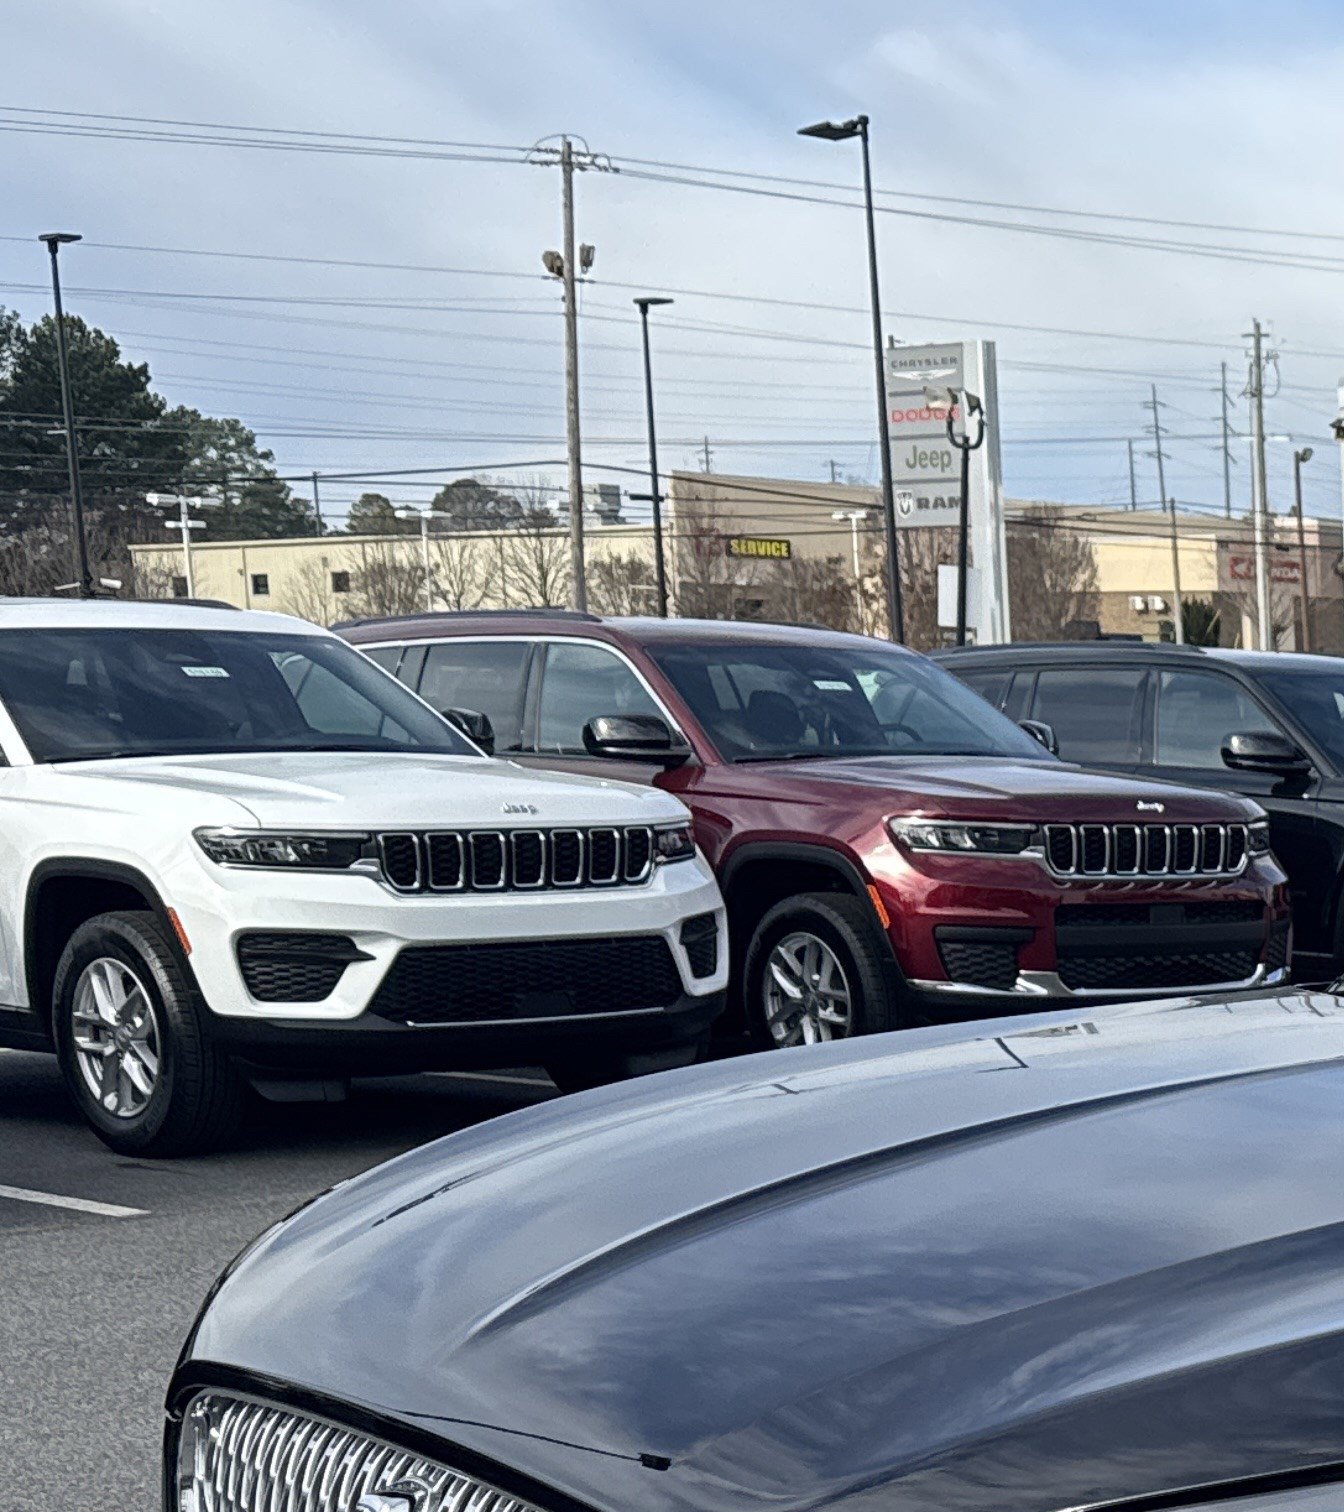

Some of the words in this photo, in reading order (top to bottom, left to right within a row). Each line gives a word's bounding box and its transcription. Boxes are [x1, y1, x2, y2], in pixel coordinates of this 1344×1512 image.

[891, 357, 958, 369] CHRYSLER
[905, 445, 952, 472] Jeep
[730, 539, 789, 558] SERVICE
